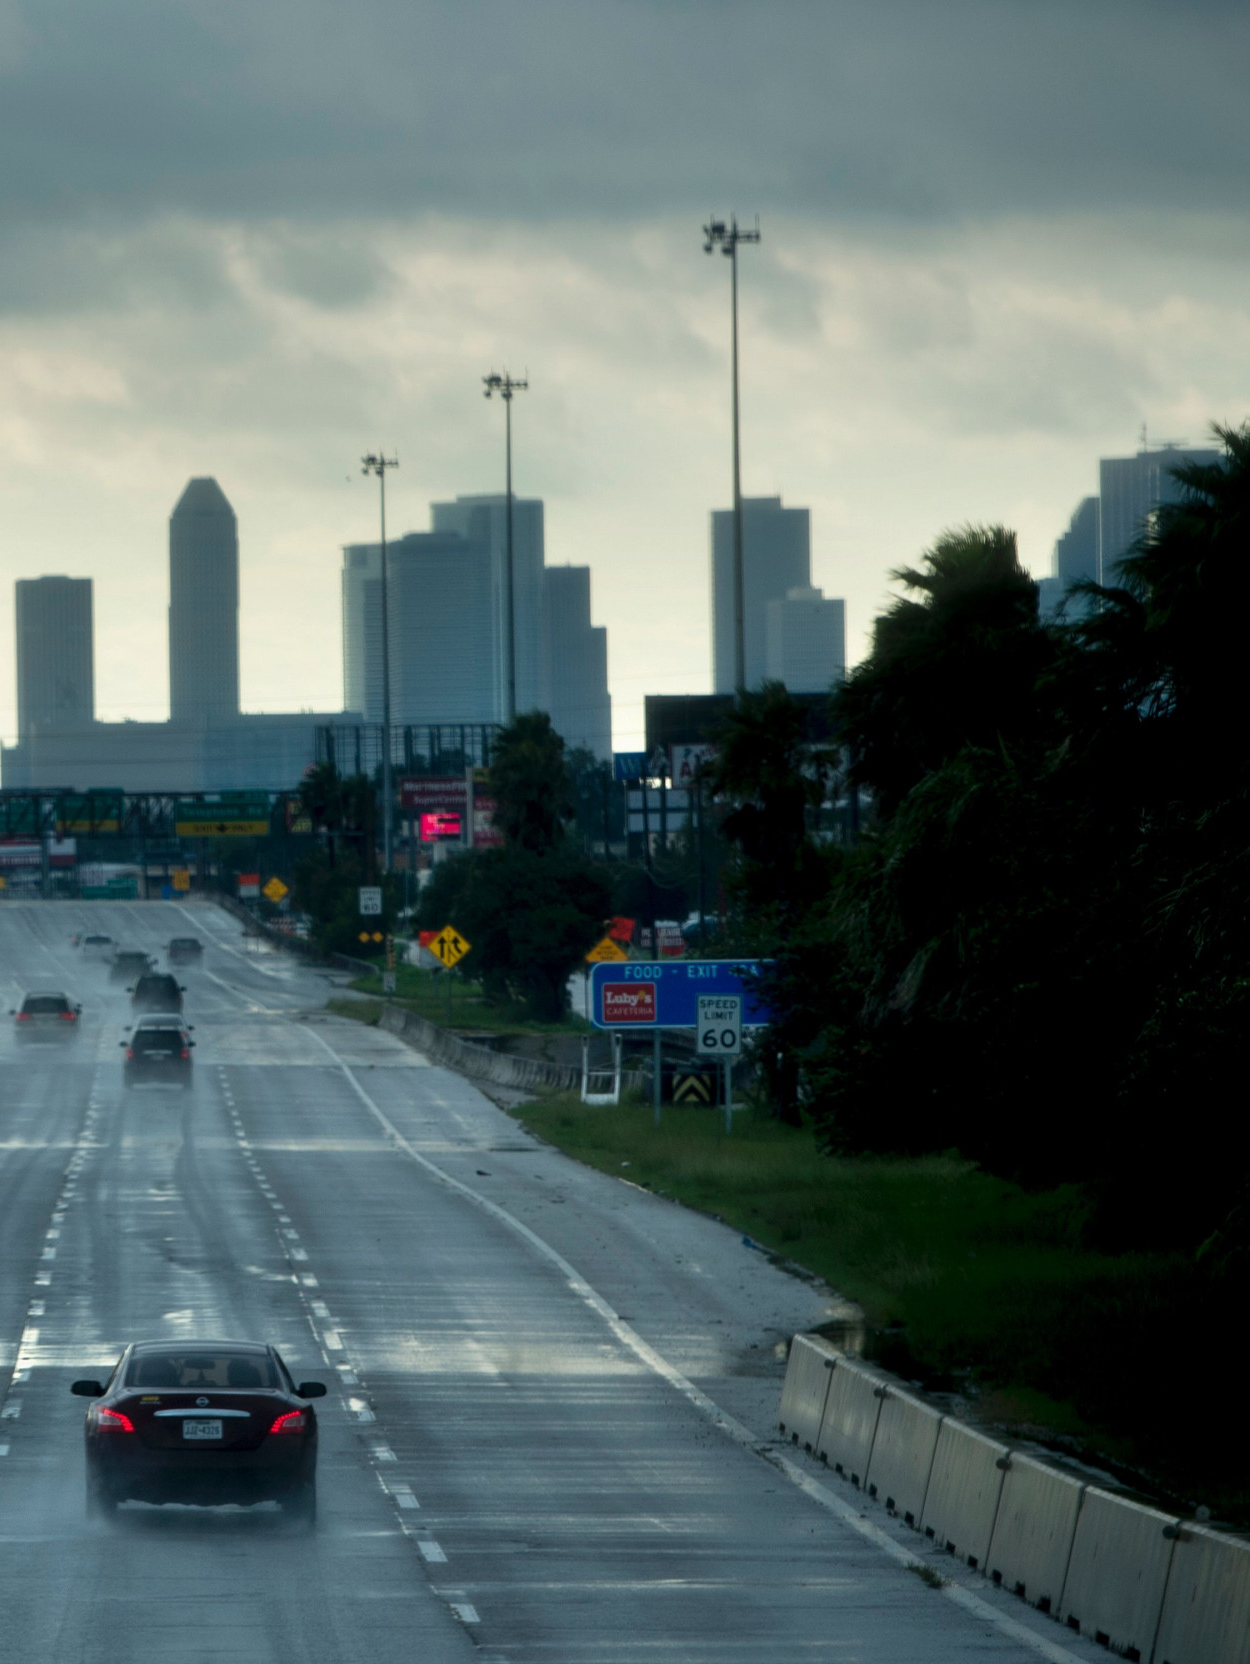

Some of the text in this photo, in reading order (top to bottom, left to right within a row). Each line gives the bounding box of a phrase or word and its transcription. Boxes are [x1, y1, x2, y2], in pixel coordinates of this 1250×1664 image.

[624, 966, 663, 979] FOOD
[687, 965, 718, 979] EXIT
[605, 991, 653, 1006] Luby's
[699, 999, 738, 1009] SPEED
[606, 1007, 653, 1016] CAFETERIA
[704, 1011, 735, 1021] LIMIT
[702, 1028, 736, 1048] 60
